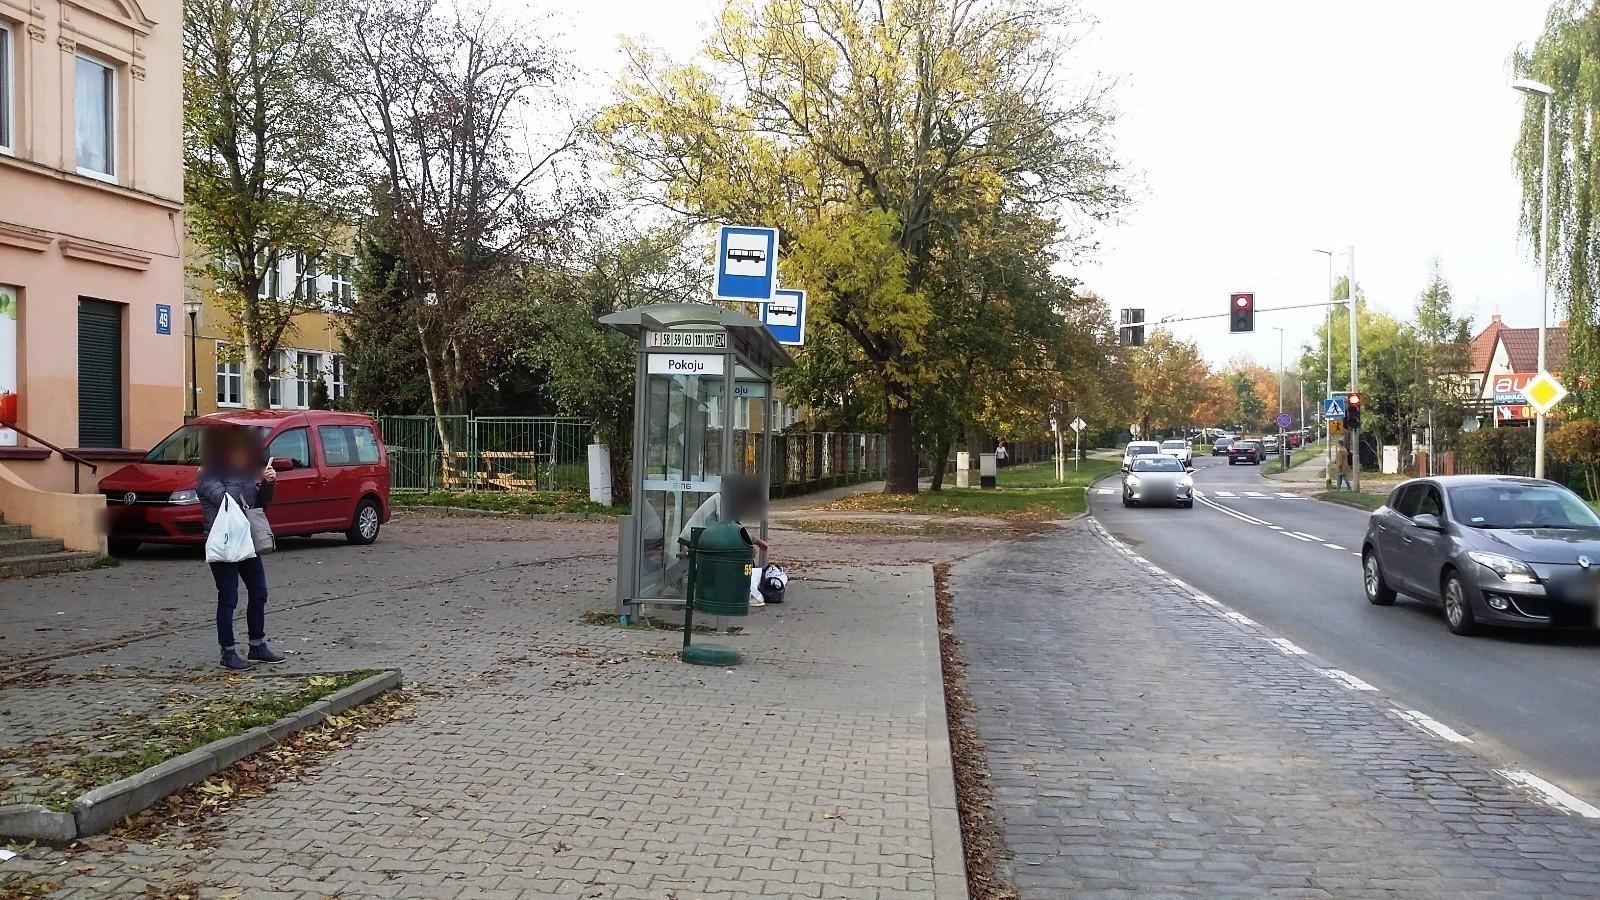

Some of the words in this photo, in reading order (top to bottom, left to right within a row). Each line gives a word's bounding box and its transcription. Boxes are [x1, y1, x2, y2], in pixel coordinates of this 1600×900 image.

[159, 312, 168, 328] 49
[663, 333, 671, 346] 58
[673, 334, 682, 346] 59
[684, 334, 692, 346] 63
[668, 359, 704, 372] Pokoju
[719, 385, 748, 396] Poju
